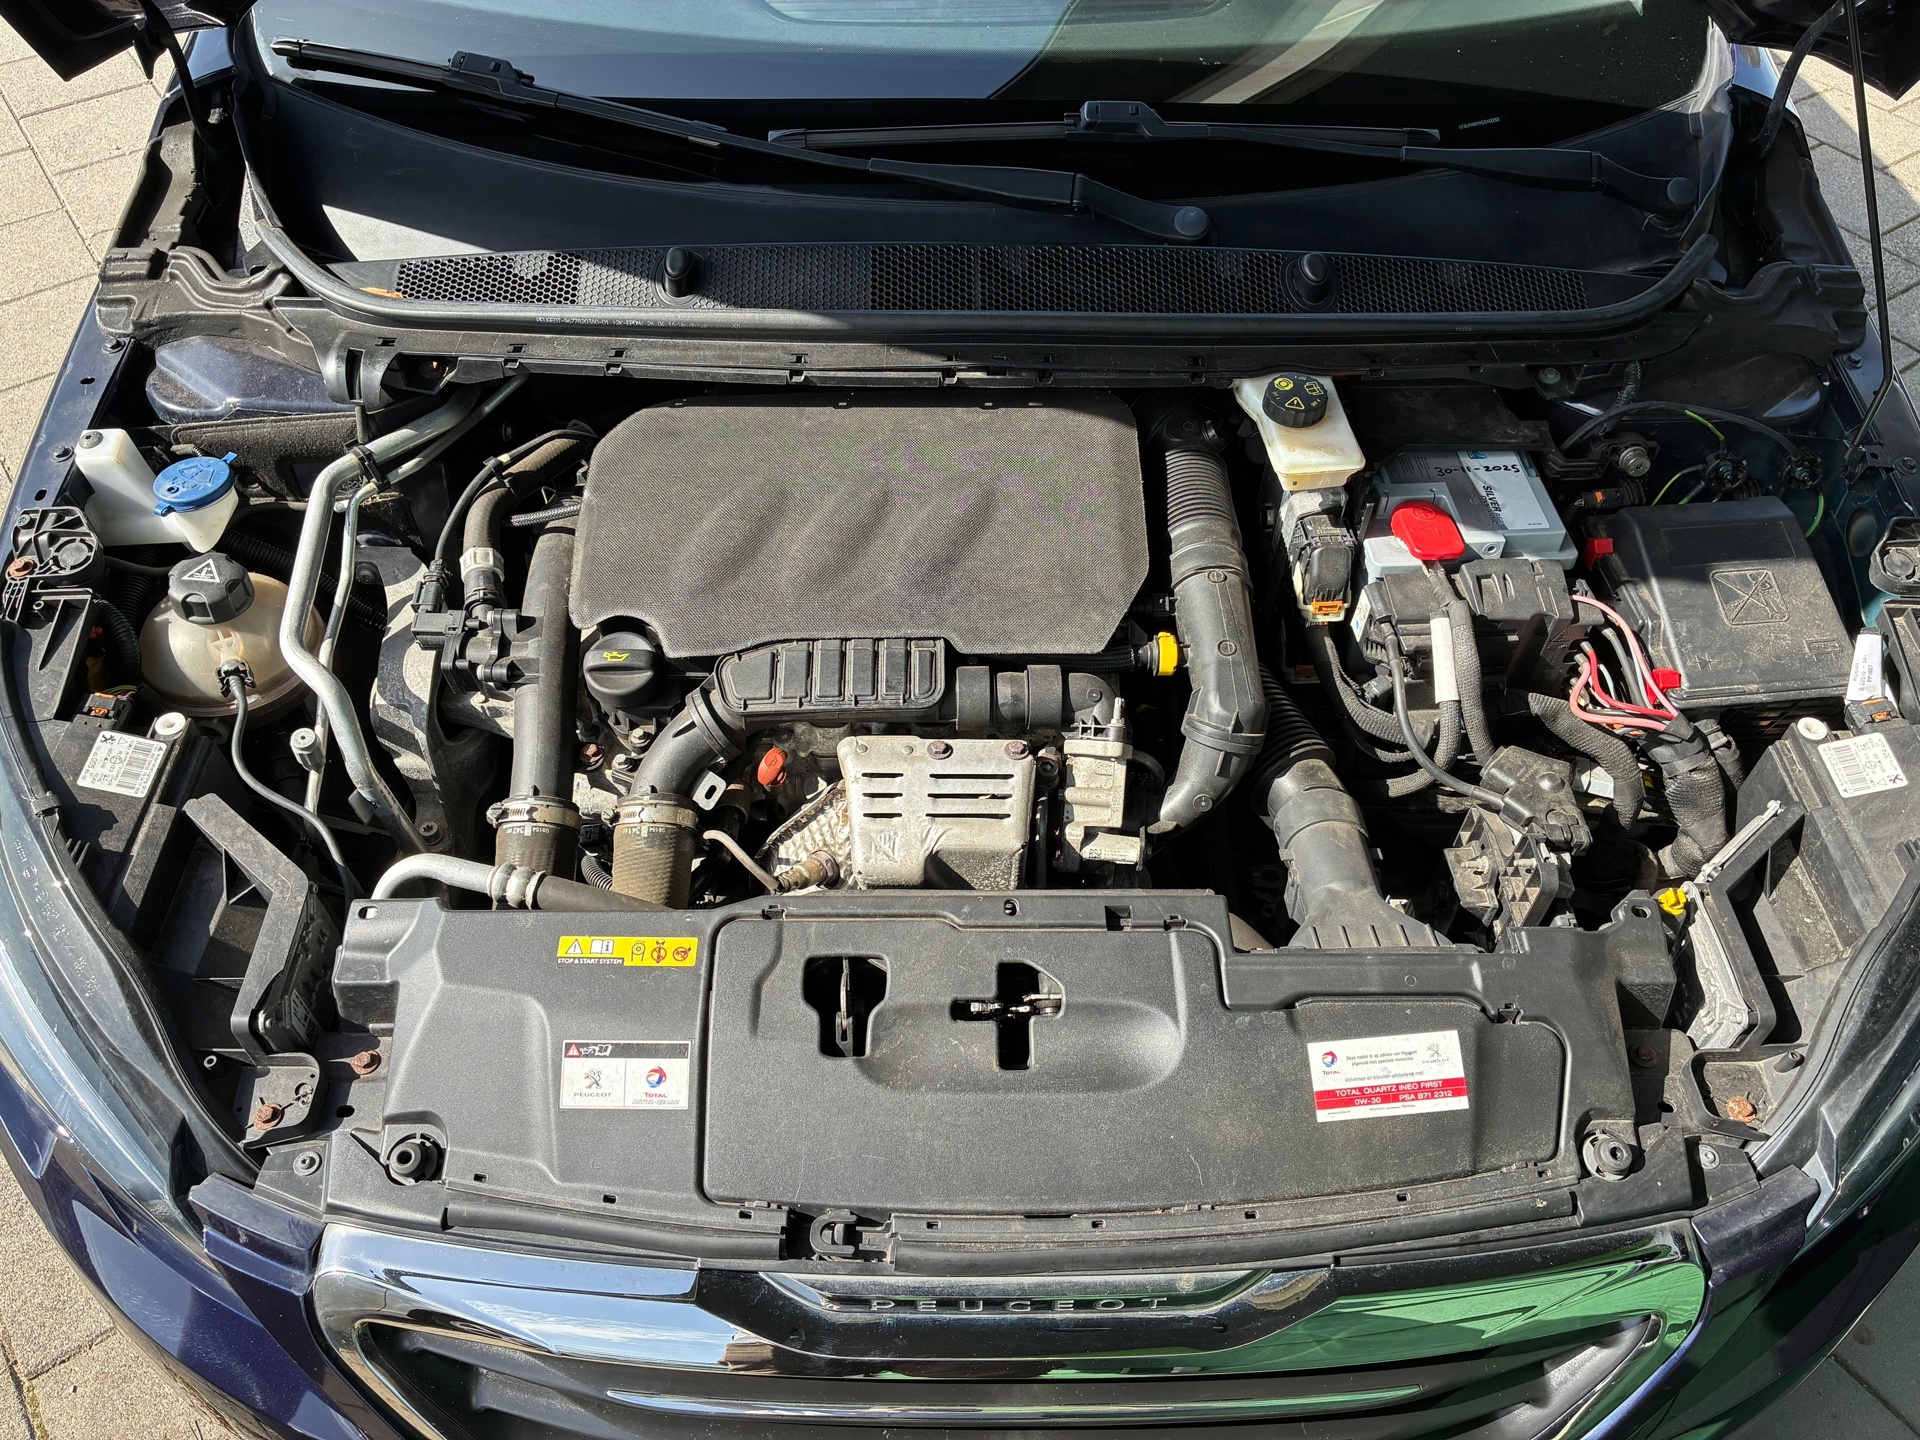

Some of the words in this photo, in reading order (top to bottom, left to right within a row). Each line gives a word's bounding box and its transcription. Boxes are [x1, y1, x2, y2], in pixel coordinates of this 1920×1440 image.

[1482, 484, 1502, 512] SILVER
[1364, 1085, 1396, 1094] QUARTZ
[1399, 1082, 1418, 1090] INEO
[1354, 1097, 1381, 1105] 0W-30
[868, 1296, 1168, 1312] PEUGEOT
